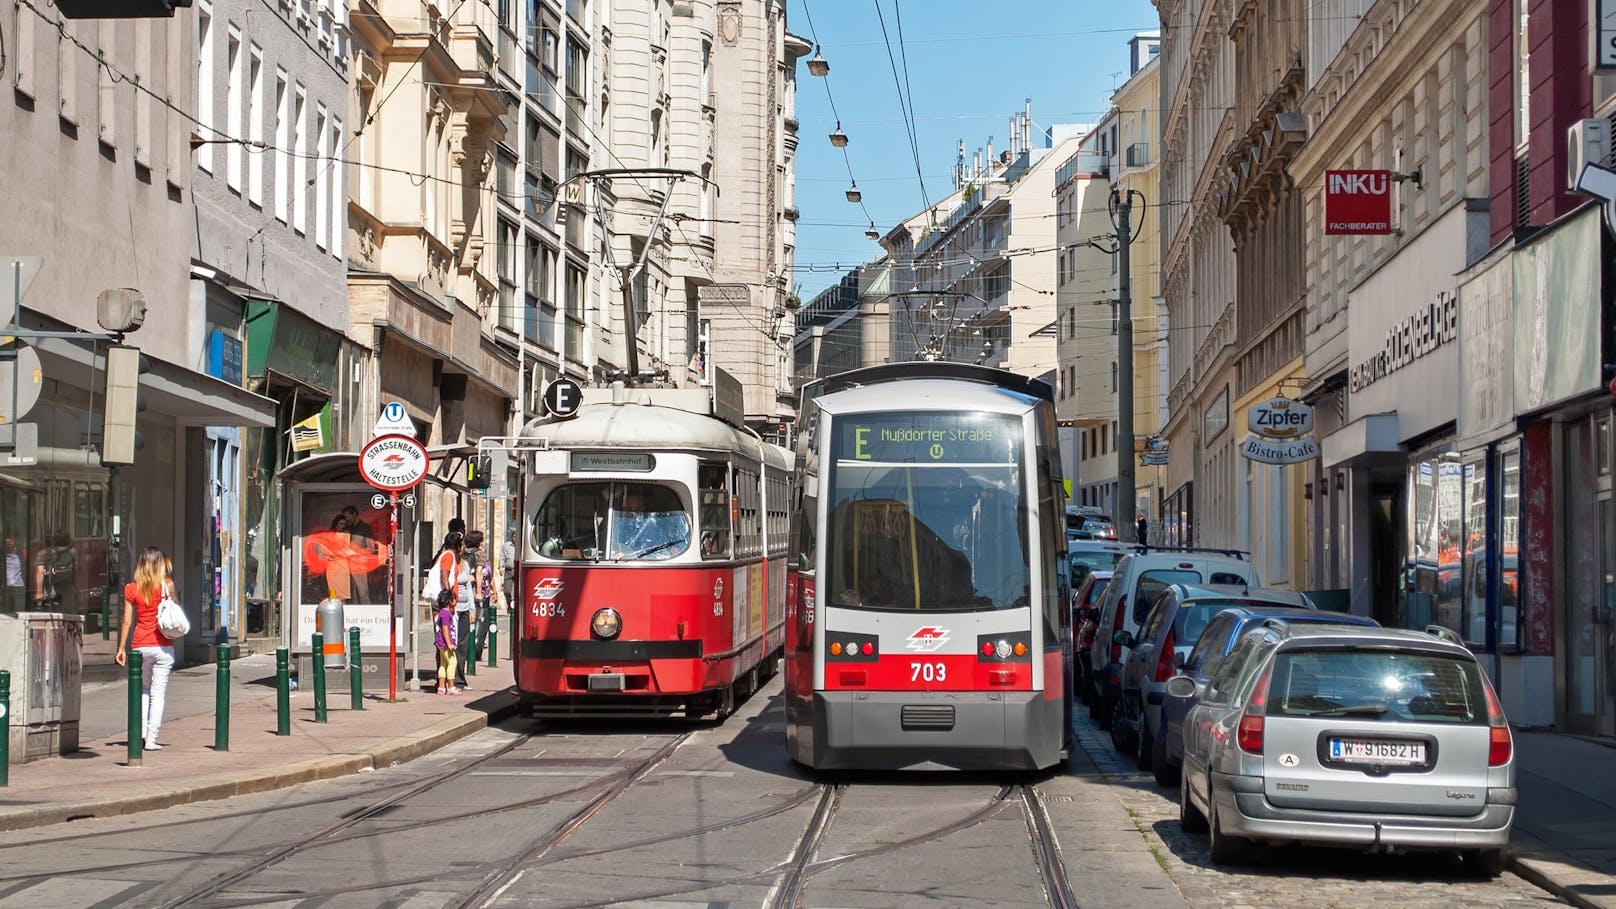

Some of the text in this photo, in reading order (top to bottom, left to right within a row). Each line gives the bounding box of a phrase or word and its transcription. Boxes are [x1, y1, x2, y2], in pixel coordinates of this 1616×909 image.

[1329, 174, 1387, 195] INKU
[1330, 222, 1387, 230] FACHBERATER
[556, 384, 571, 412] E
[1256, 409, 1308, 429] Zipfer
[367, 441, 421, 460] STRASSENBAHN
[855, 427, 872, 460] E
[948, 428, 992, 442] Straße
[591, 456, 642, 465] Westbahnhof
[369, 468, 419, 485] HALTESTELLE
[374, 496, 383, 505] E
[406, 496, 414, 505] 5
[532, 602, 566, 617] 4834
[910, 662, 946, 682] 703
[1344, 741, 1354, 756] W
[1365, 742, 1407, 758] 91682
[1410, 744, 1419, 759] H
[1284, 755, 1294, 765] A
